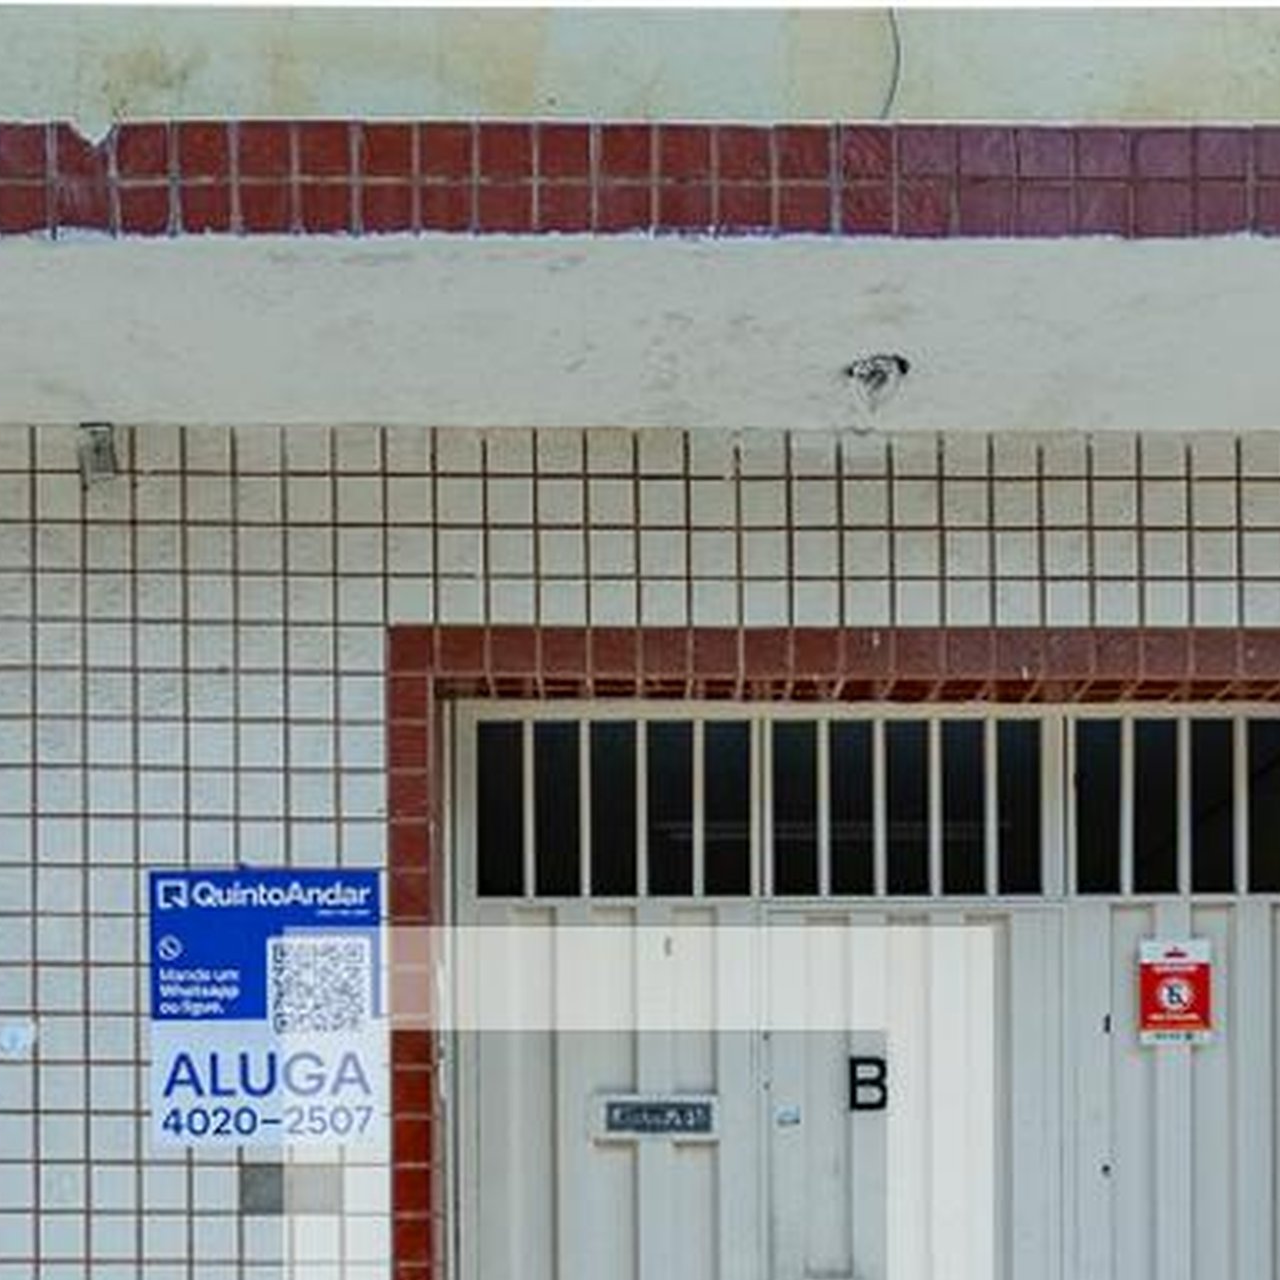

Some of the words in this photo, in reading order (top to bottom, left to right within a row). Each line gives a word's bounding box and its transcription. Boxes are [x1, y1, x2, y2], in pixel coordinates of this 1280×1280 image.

[192, 880, 371, 908] QuintoAndar
[163, 1052, 371, 1098] ALUGA
[849, 1056, 888, 1111] B
[162, 1105, 372, 1136] 4020-2507
